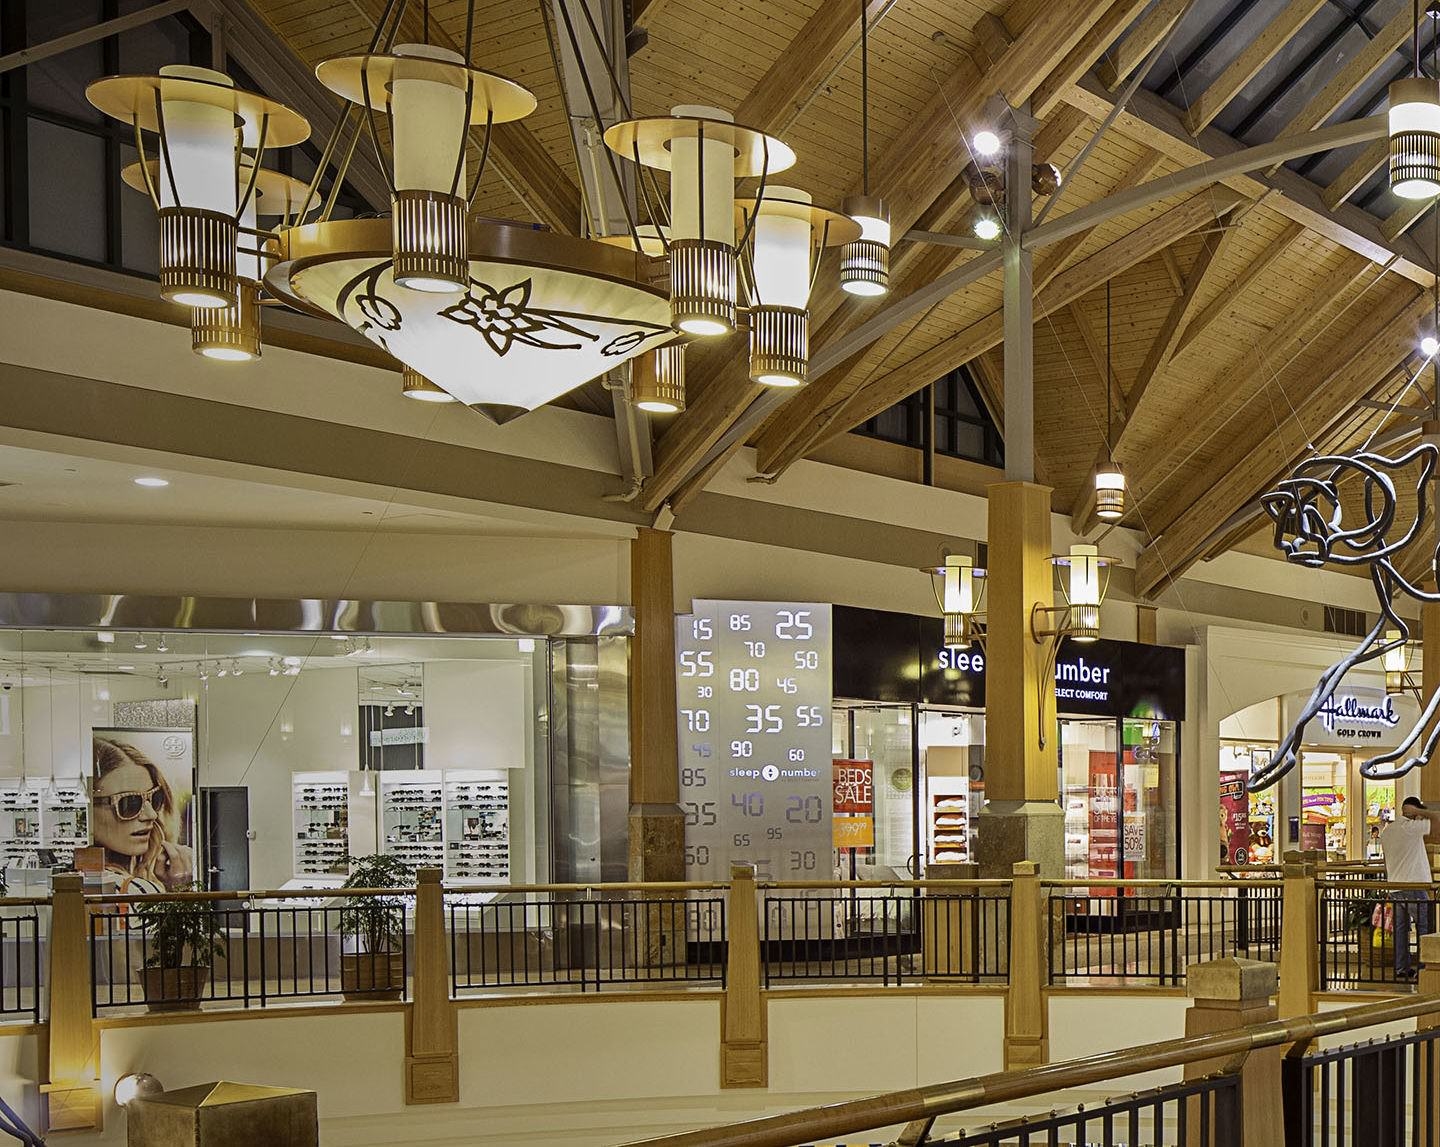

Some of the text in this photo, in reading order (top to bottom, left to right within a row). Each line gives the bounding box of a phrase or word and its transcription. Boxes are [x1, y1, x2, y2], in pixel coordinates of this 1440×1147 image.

[693, 618, 713, 640] 15
[729, 614, 751, 631] 85
[775, 610, 813, 640] 25
[744, 641, 765, 658] 70
[680, 651, 714, 677] 55
[794, 651, 818, 669] 50
[938, 648, 983, 672] slee
[729, 668, 759, 692] 80
[1055, 658, 1110, 684] umber
[697, 686, 713, 698] 30
[777, 677, 798, 694] 45
[1054, 688, 1108, 701] ELECT COMFORT
[746, 704, 783, 733] 35
[796, 705, 823, 727] 55
[1318, 692, 1400, 730] Hallmark
[681, 710, 710, 732] 70
[1337, 729, 1382, 738] GOLD CROWN
[730, 741, 752, 757] 90
[788, 749, 805, 762] 60
[681, 768, 706, 787] 85
[729, 767, 760, 780] sleep
[838, 768, 872, 786] BEDS
[835, 785, 872, 804] SALE
[731, 791, 764, 817] 40
[785, 795, 822, 824] 20
[767, 827, 782, 840] 95
[1124, 825, 1144, 836] SAVE
[733, 834, 750, 847] 65
[1124, 837, 1144, 851] 50%
[790, 851, 815, 870] 30
